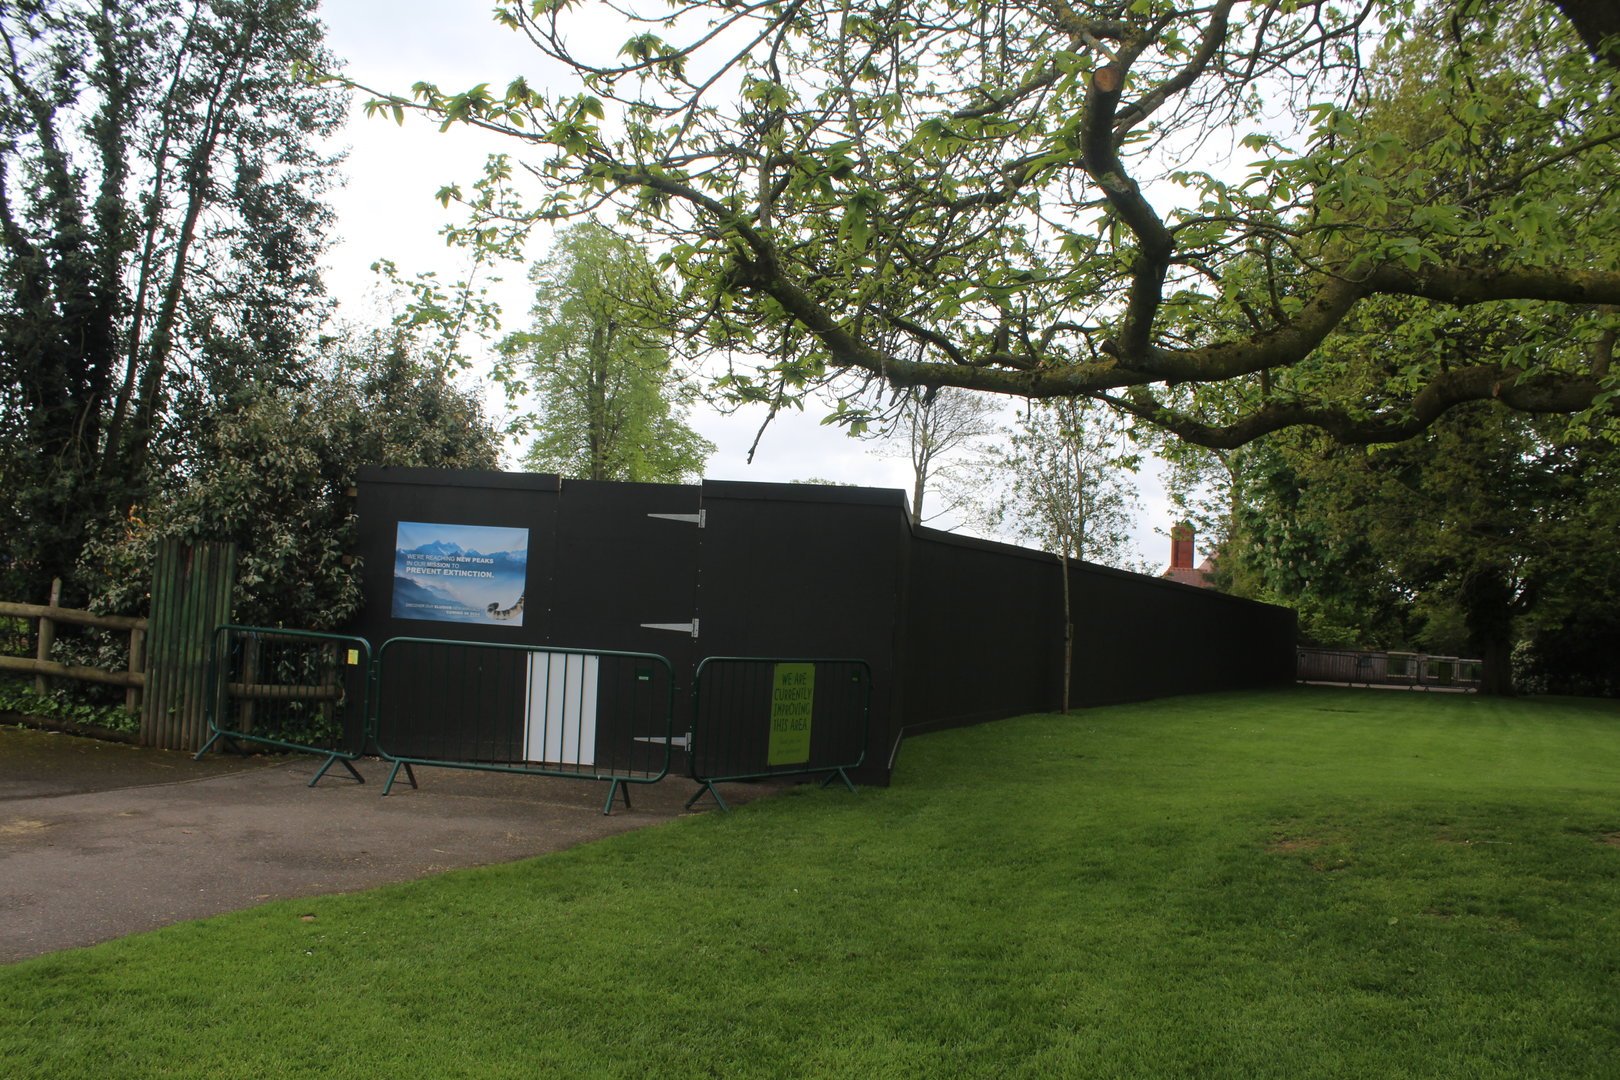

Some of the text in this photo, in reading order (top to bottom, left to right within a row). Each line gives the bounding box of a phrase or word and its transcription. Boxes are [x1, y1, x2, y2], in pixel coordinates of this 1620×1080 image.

[444, 569, 495, 578] EXTINCTION.
[782, 672, 806, 685] WE ARE
[774, 688, 812, 700] CURRENTLY
[774, 703, 811, 716] IMPROVING
[774, 719, 808, 732] THIS AREA
